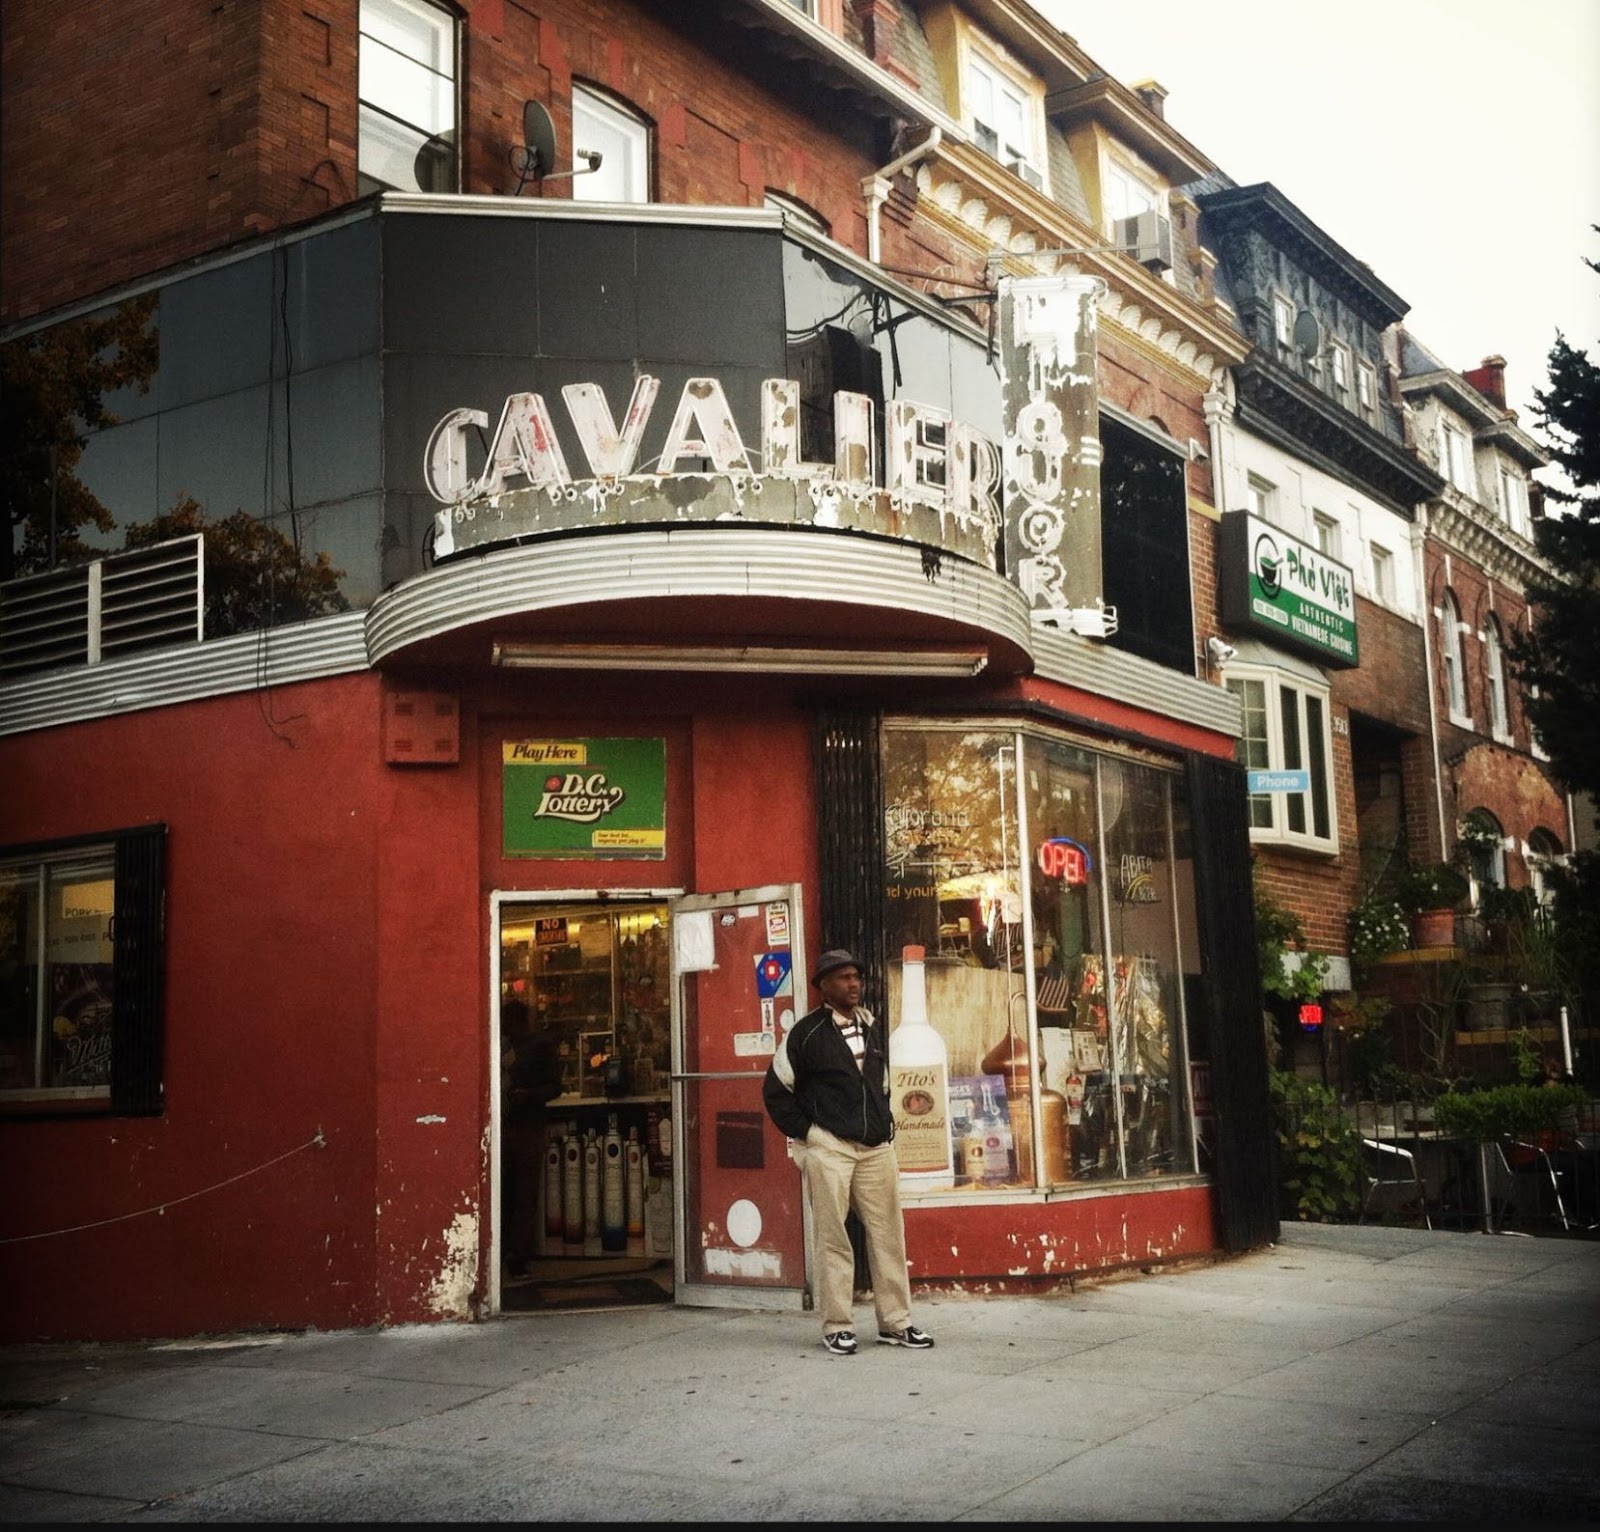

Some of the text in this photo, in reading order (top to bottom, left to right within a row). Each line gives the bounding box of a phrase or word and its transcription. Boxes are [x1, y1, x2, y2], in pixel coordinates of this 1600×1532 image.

[423, 375, 1003, 530] CAVALIER
[1299, 602, 1344, 633] AUTHENTIC
[512, 744, 578, 762] Play Here
[559, 773, 609, 796] D.C.
[1257, 774, 1299, 788] Phone
[533, 786, 624, 823] Lottery
[1120, 853, 1153, 889] ABITA
[543, 918, 560, 931] NO
[897, 1072, 937, 1088] Tito's
[894, 1117, 946, 1132] Handmade
